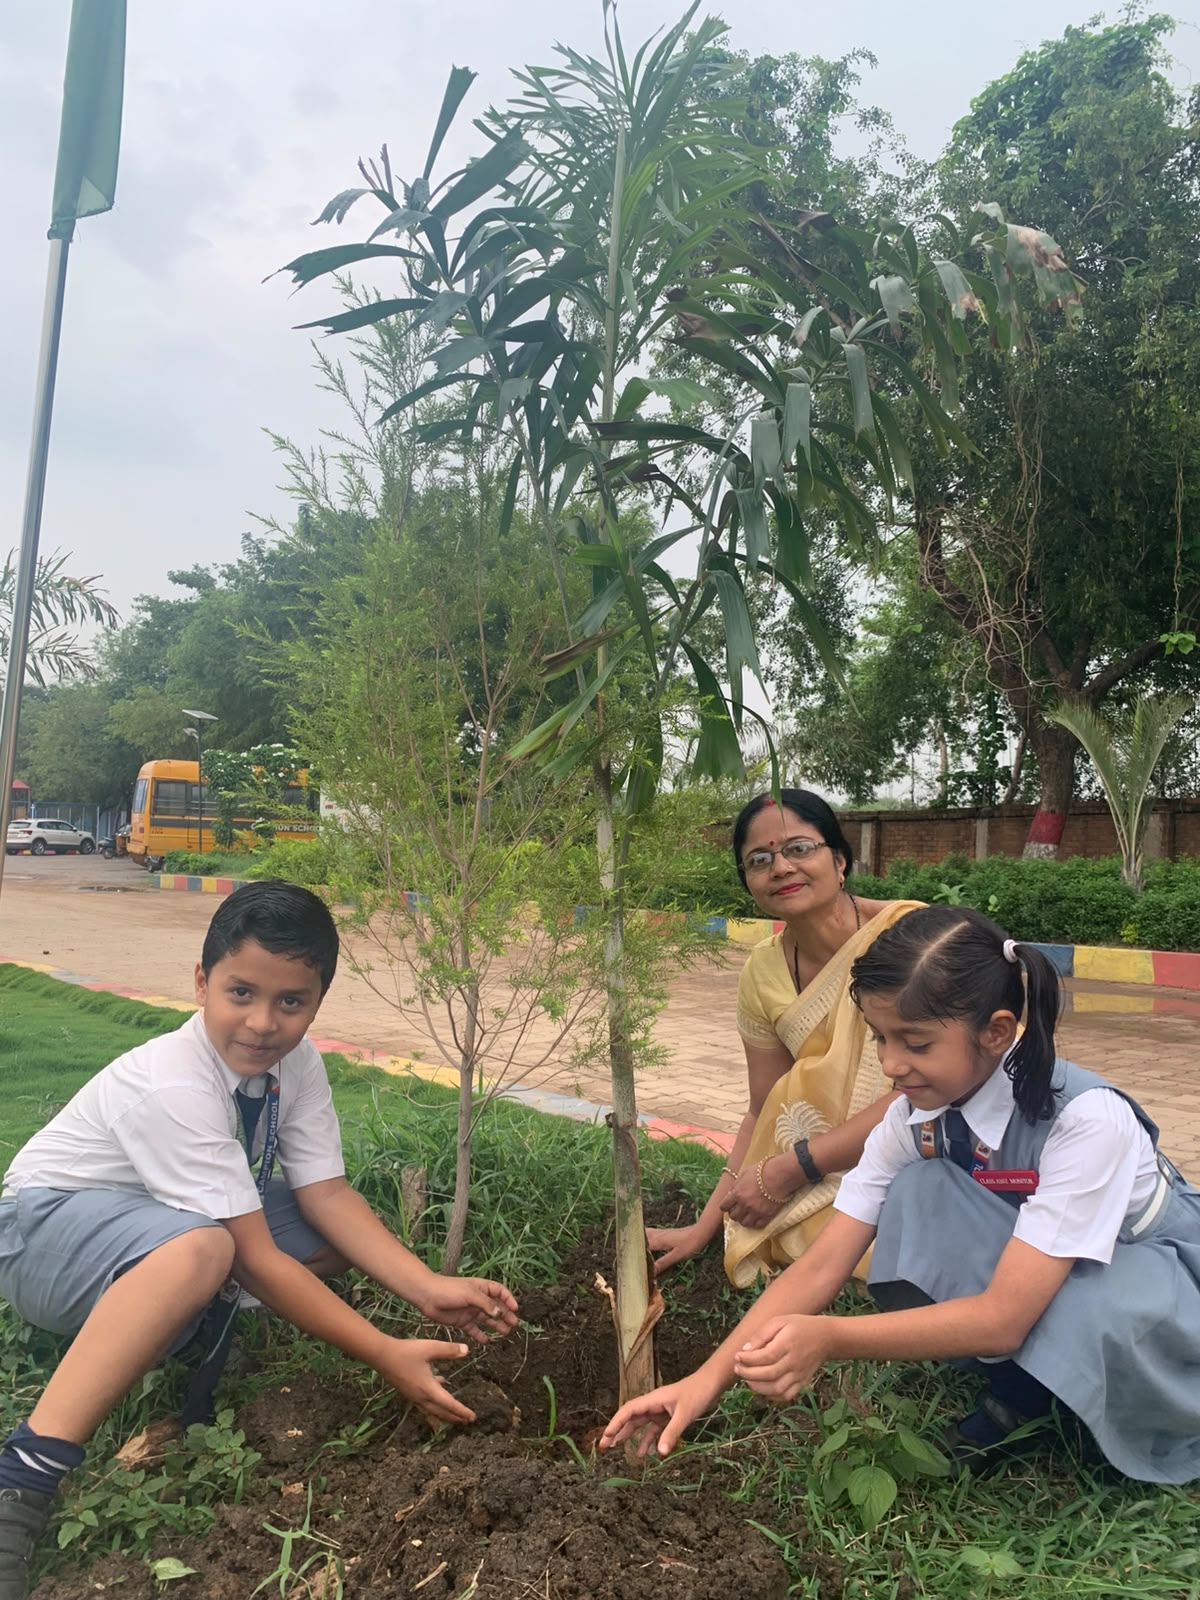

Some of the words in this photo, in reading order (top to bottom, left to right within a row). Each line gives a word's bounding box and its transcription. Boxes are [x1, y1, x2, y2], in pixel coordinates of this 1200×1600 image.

[251, 823, 290, 832] CION
[292, 824, 324, 832] SCHOO
[258, 1145, 272, 1193] CAMPION
[269, 1100, 278, 1142] SCHOOL
